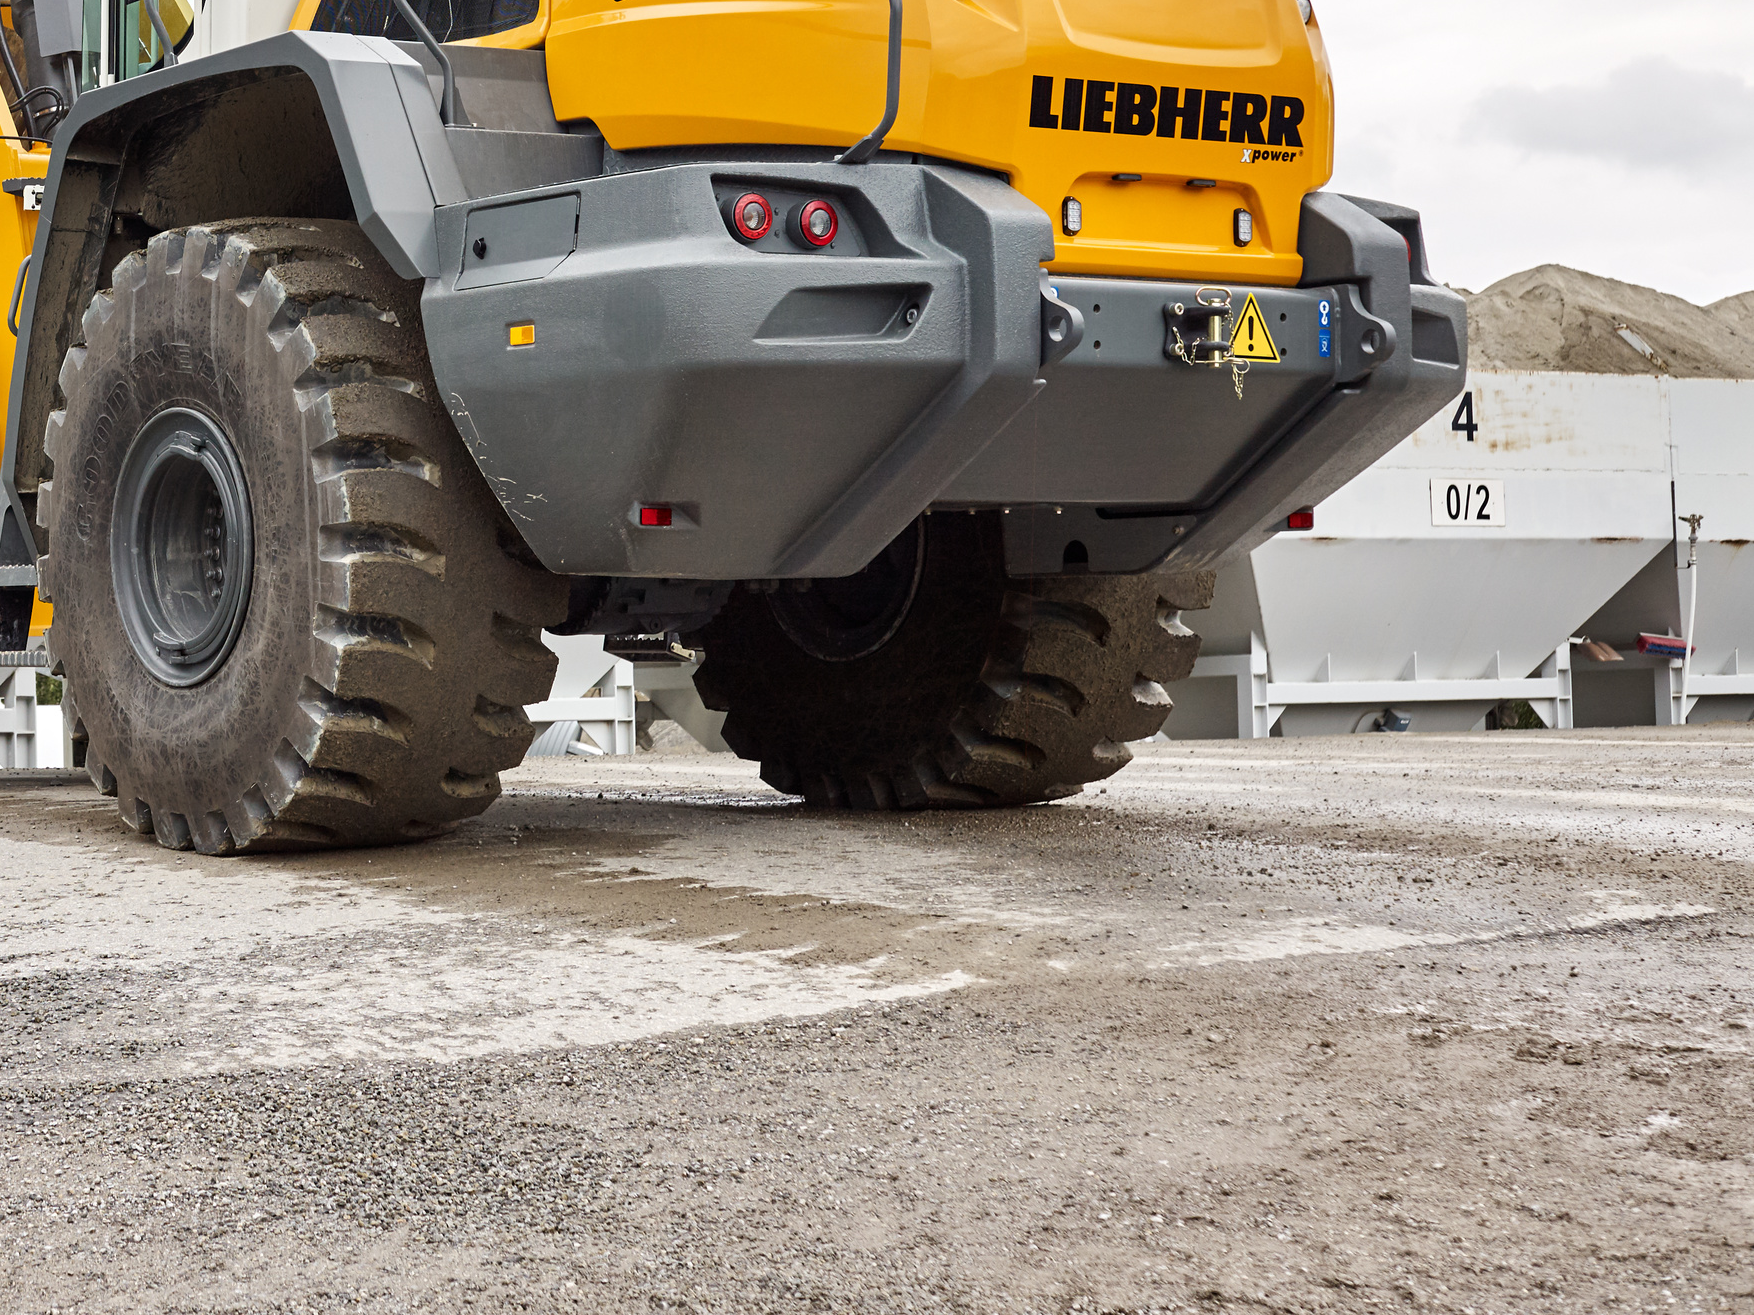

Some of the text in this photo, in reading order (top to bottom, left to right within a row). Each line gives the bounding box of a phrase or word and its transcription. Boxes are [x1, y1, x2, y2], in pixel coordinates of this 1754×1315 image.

[1029, 74, 1305, 148] LIEBHERR
[1451, 391, 1478, 442] 4
[1446, 484, 1491, 520] 0/2
